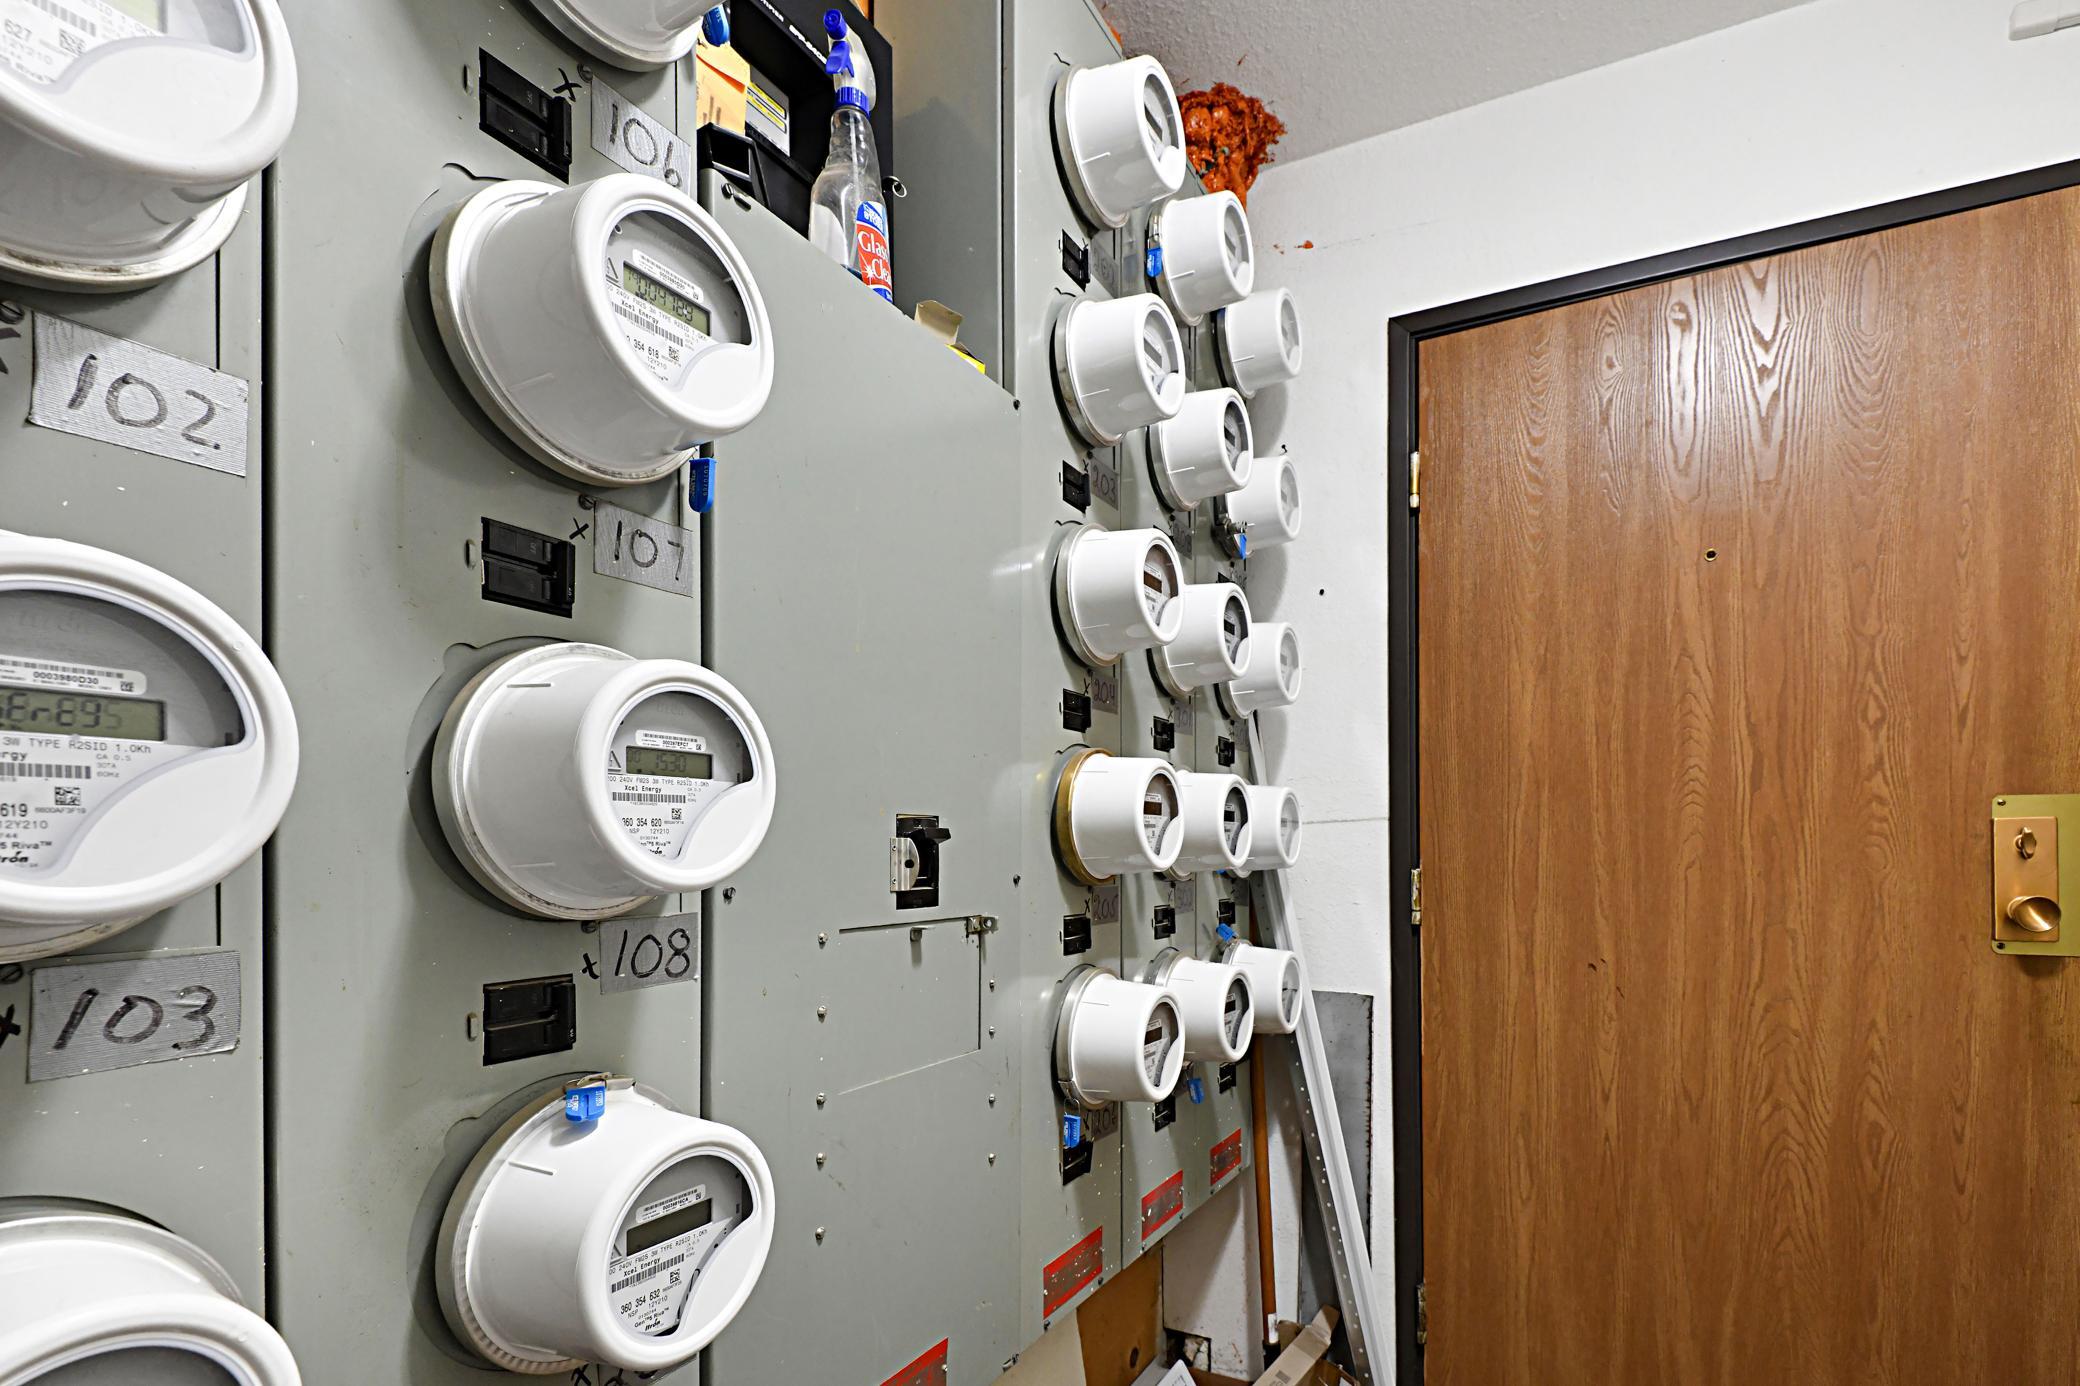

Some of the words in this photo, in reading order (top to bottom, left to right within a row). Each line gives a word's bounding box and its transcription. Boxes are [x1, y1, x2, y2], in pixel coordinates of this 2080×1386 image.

[4, 18, 32, 41] 627
[609, 102, 682, 188] 106
[638, 307, 660, 325] Energy
[67, 353, 221, 450] 102
[614, 520, 685, 581] 107
[29, 737, 61, 749] TYPE
[641, 786, 662, 794] Energy
[0, 803, 28, 817] 619
[636, 818, 648, 827] 354
[651, 818, 662, 827] 620
[614, 928, 690, 978] 108
[53, 984, 218, 1051] 103
[623, 1266, 638, 1277] Xcel
[640, 1257, 661, 1273] Energy
[620, 1302, 633, 1315] 360
[635, 1296, 647, 1309] 354
[650, 1288, 661, 1301] 632
